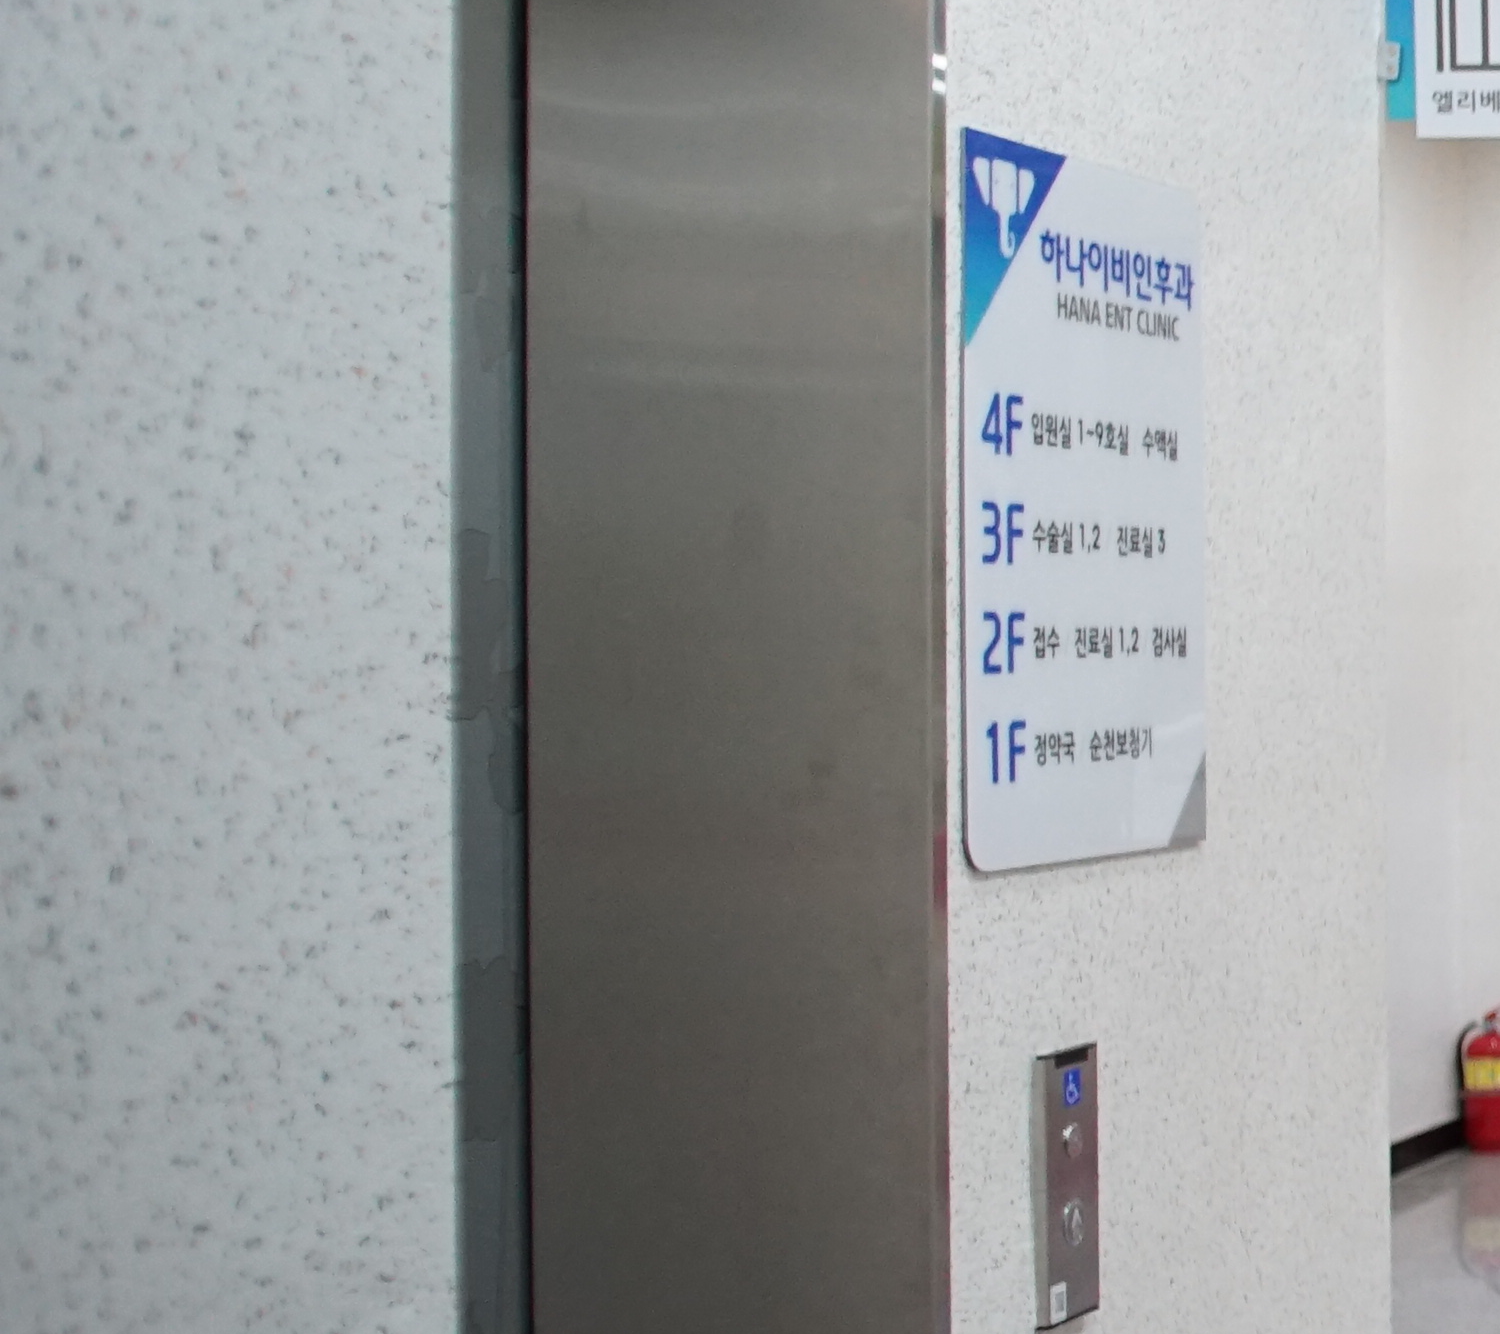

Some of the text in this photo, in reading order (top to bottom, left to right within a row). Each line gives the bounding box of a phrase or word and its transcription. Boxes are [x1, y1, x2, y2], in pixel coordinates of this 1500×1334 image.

[1039, 228, 1195, 312] 하나이비인후과
[1057, 292, 1180, 342] HANA ENT CLINIC
[981, 392, 1024, 456] 4F
[1031, 412, 1072, 449] 입원실
[981, 500, 1025, 565] 3F
[1032, 519, 1166, 558] 수술실 1,2 진료실 3
[982, 611, 1026, 674] 2F
[1033, 625, 1187, 659] 접수 진료실 1,2 검사실
[986, 719, 1027, 784] 1F
[1034, 725, 1153, 767] 정약국 순천보청기
